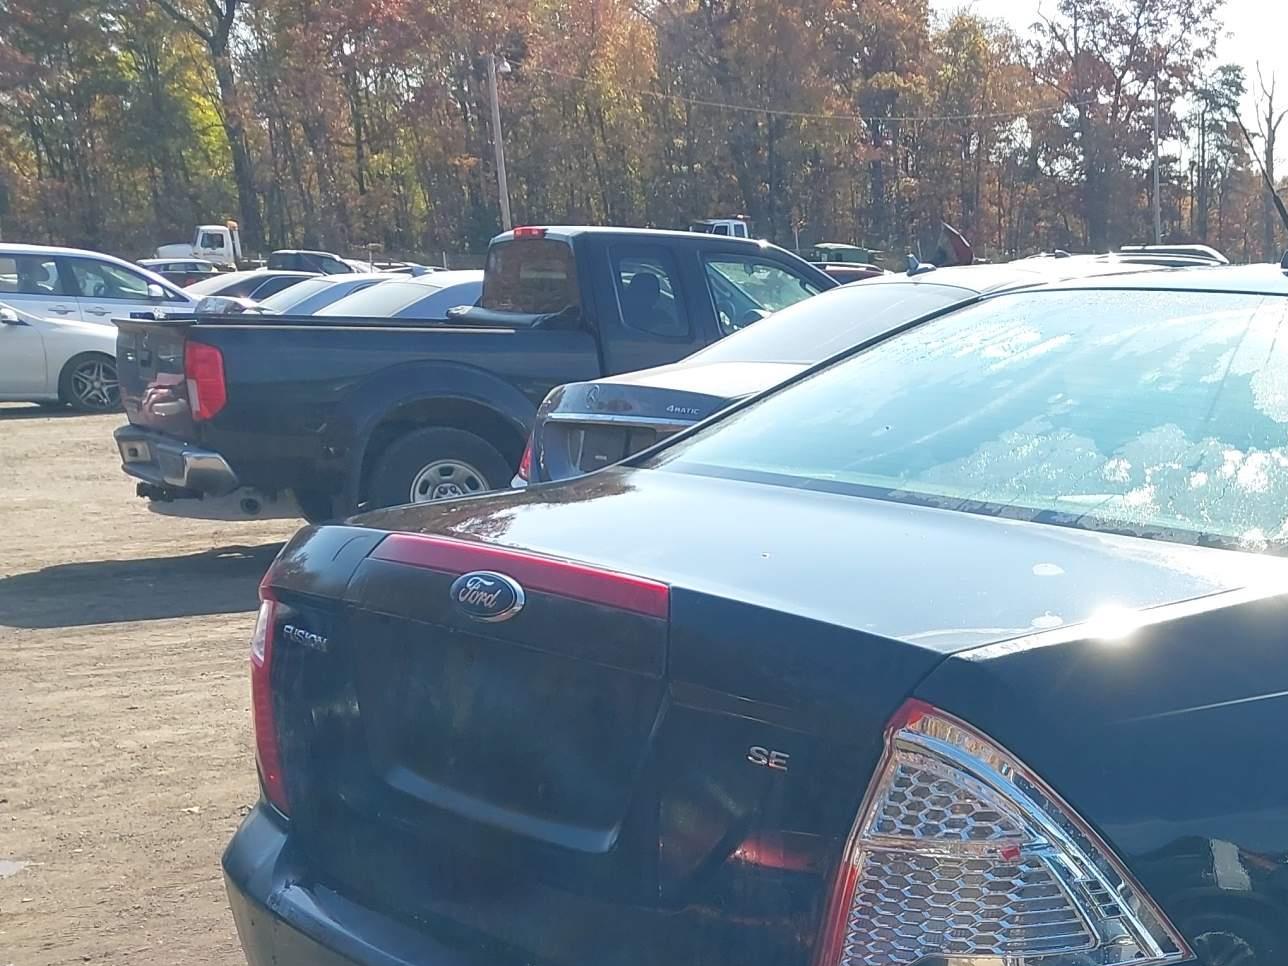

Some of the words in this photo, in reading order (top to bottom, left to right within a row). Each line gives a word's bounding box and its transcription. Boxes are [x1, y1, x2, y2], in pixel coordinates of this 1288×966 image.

[666, 404, 700, 415] 4MATIC
[458, 576, 502, 609] Ford
[283, 624, 328, 651] FUSION
[747, 745, 790, 773] SE
